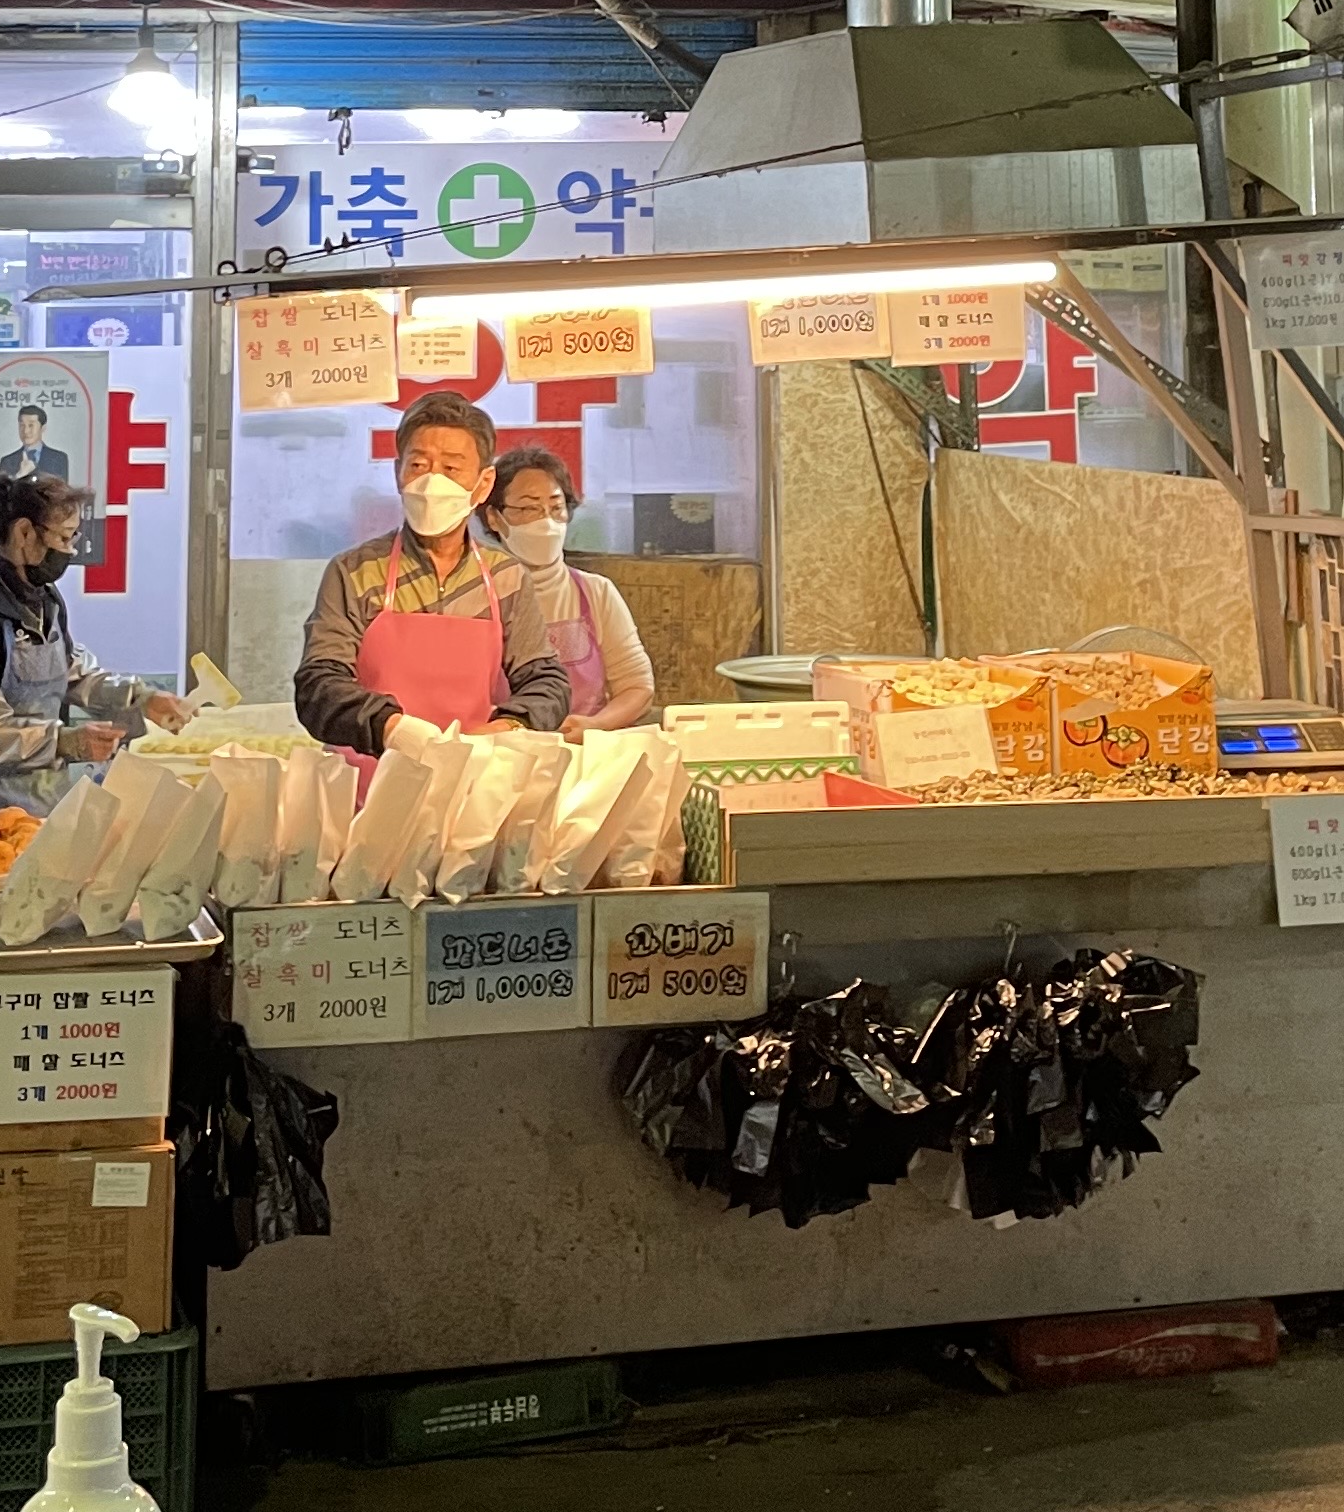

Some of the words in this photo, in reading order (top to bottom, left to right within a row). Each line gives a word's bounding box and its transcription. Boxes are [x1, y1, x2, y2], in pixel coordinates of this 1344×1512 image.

[255, 165, 418, 258] 가축
[556, 167, 654, 256] 약
[947, 291, 990, 305] 1000원
[320, 301, 378, 323] 도너츠
[761, 317, 790, 339] 1개
[798, 308, 876, 338] 1,000원
[329, 332, 387, 354] 도너츠
[518, 332, 553, 359] 1개
[563, 326, 635, 356] 500원
[948, 334, 992, 348] 2000원
[265, 370, 293, 389] 3개
[311, 364, 370, 385] 2000원
[1157, 725, 1214, 755] 단감
[333, 915, 404, 942] 도너츠
[625, 919, 735, 959] 꽈배기
[344, 955, 413, 981] 도너츠
[427, 974, 465, 1006] 1개
[476, 969, 574, 1004] 1,000원
[608, 968, 651, 1000] 1개
[663, 964, 748, 998] 500원
[52, 990, 92, 1011] 찹쌀
[99, 987, 157, 1008] 도너츠
[263, 1000, 297, 1024] 3개
[318, 994, 388, 1020] 2000원
[20, 1023, 50, 1041] 1개
[59, 1021, 122, 1040] 1000원
[69, 1049, 128, 1069] 도너츠
[16, 1084, 47, 1103] 3개
[54, 1081, 119, 1102] 2000원
